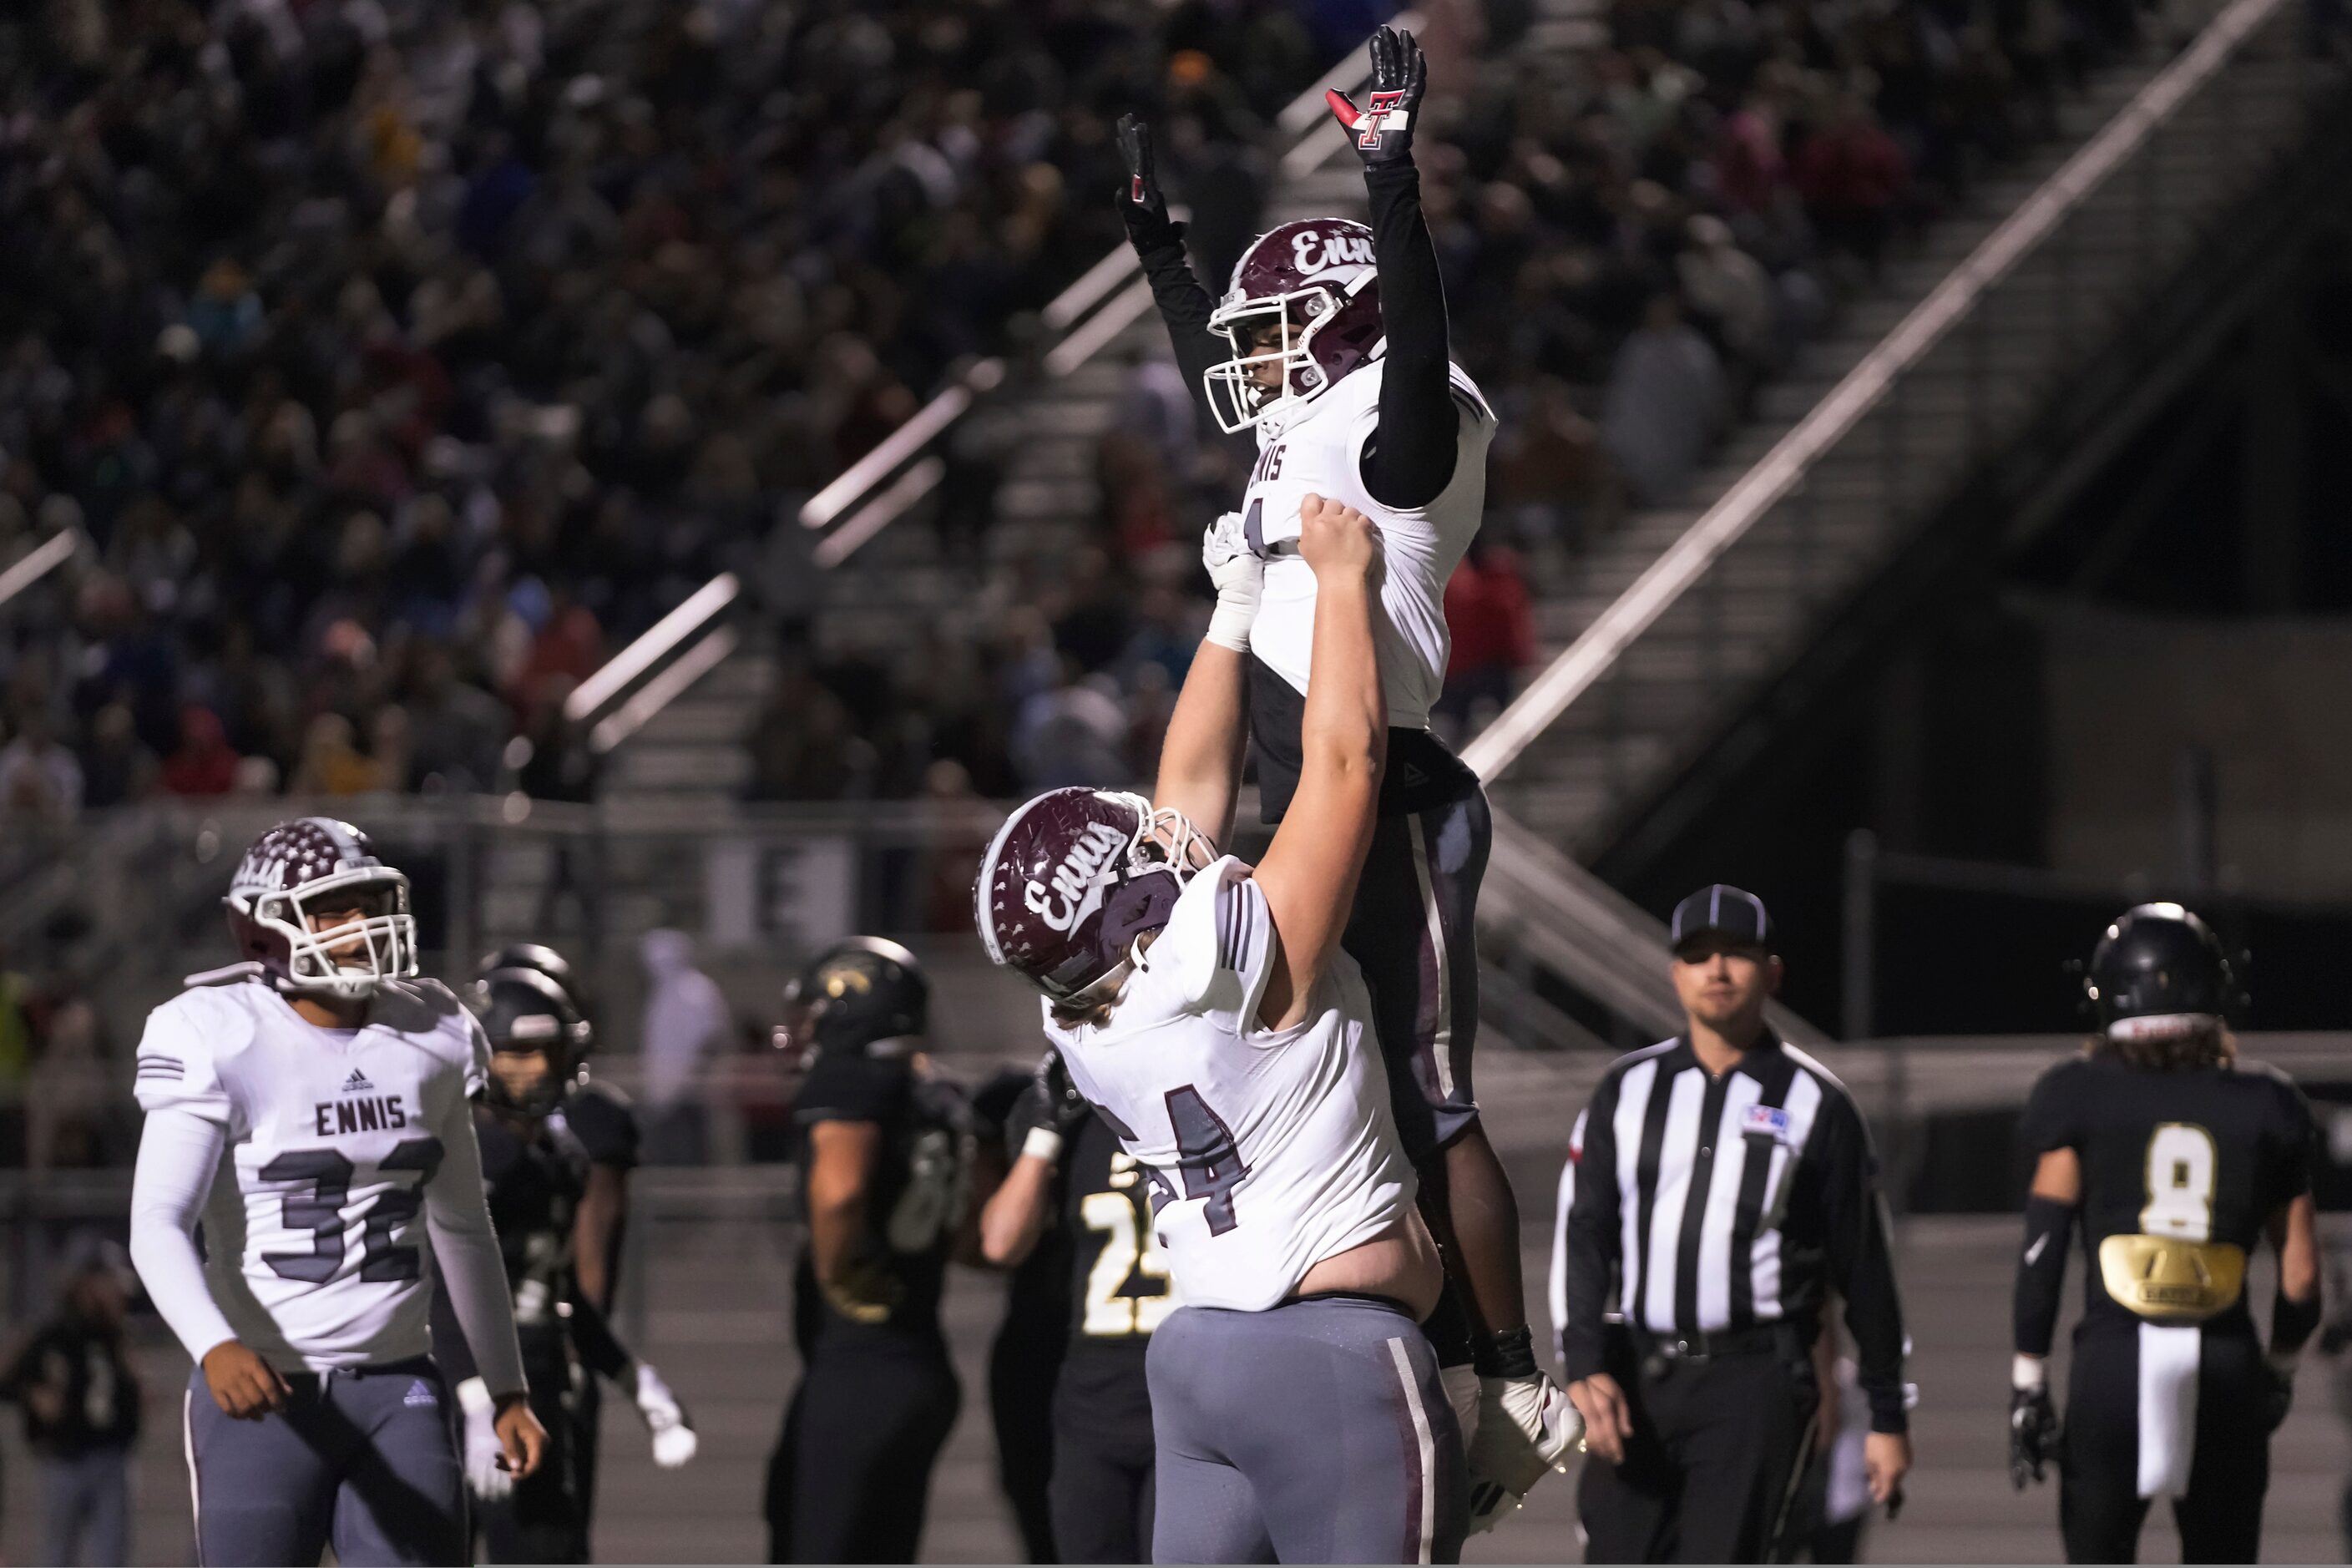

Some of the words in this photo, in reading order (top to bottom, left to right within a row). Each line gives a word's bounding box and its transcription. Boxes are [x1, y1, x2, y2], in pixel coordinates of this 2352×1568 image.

[1291, 230, 1377, 276] Enn
[1024, 821, 1126, 932] Ennis
[316, 1095, 406, 1136] ENNIS
[258, 1136, 445, 1284] 32
[2138, 1121, 2219, 1241] 8
